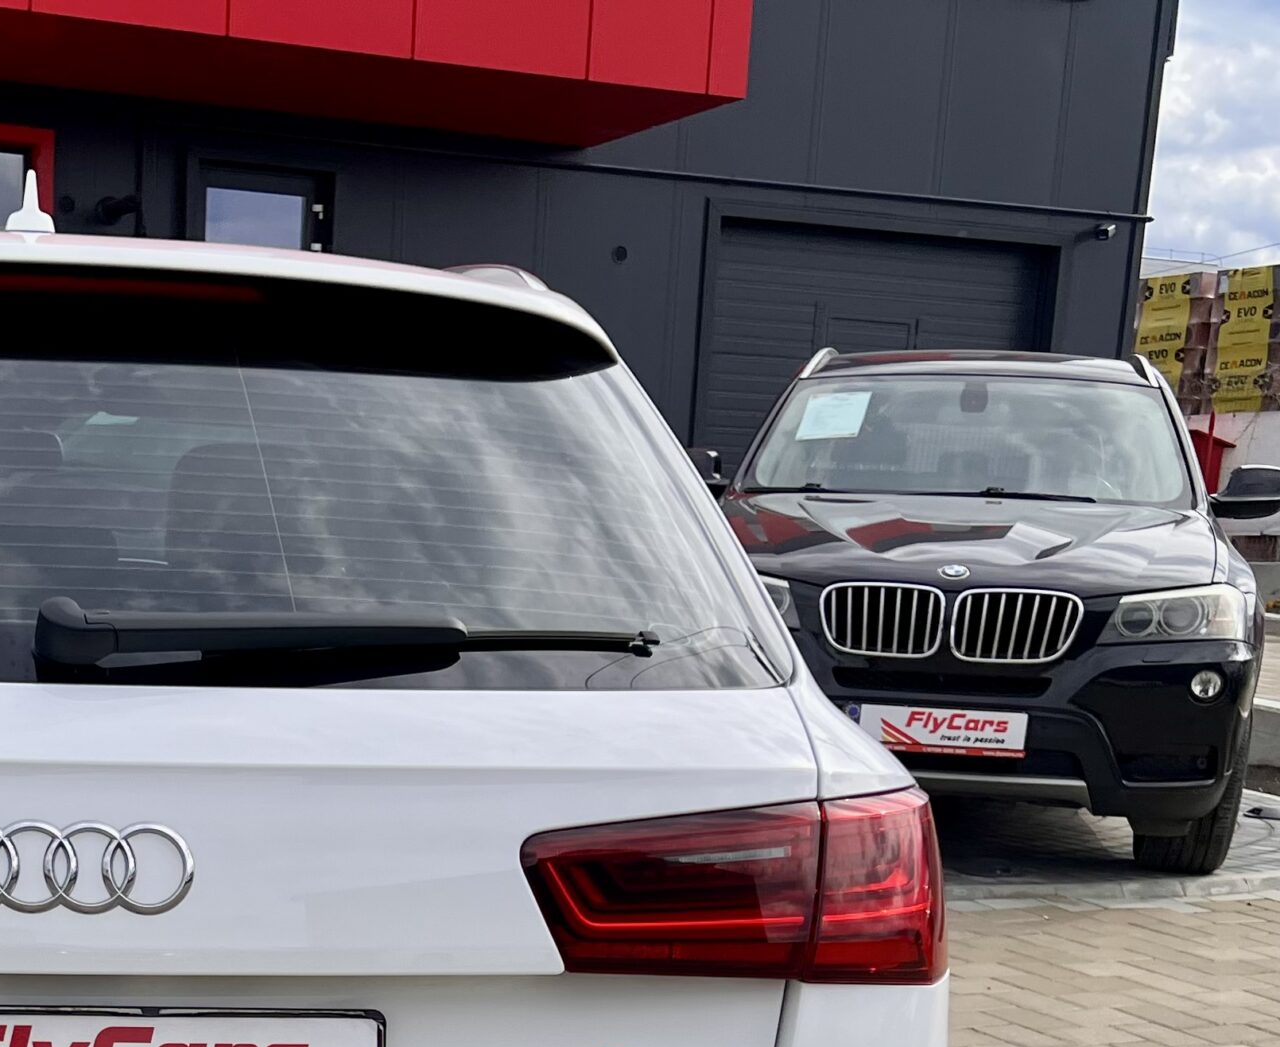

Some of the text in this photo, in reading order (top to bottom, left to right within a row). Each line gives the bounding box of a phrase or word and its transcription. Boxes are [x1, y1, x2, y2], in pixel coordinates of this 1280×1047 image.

[1159, 282, 1177, 295] EVO
[1237, 306, 1257, 318] EVO
[1149, 348, 1168, 360] EVO
[905, 710, 1009, 734] FlyCars
